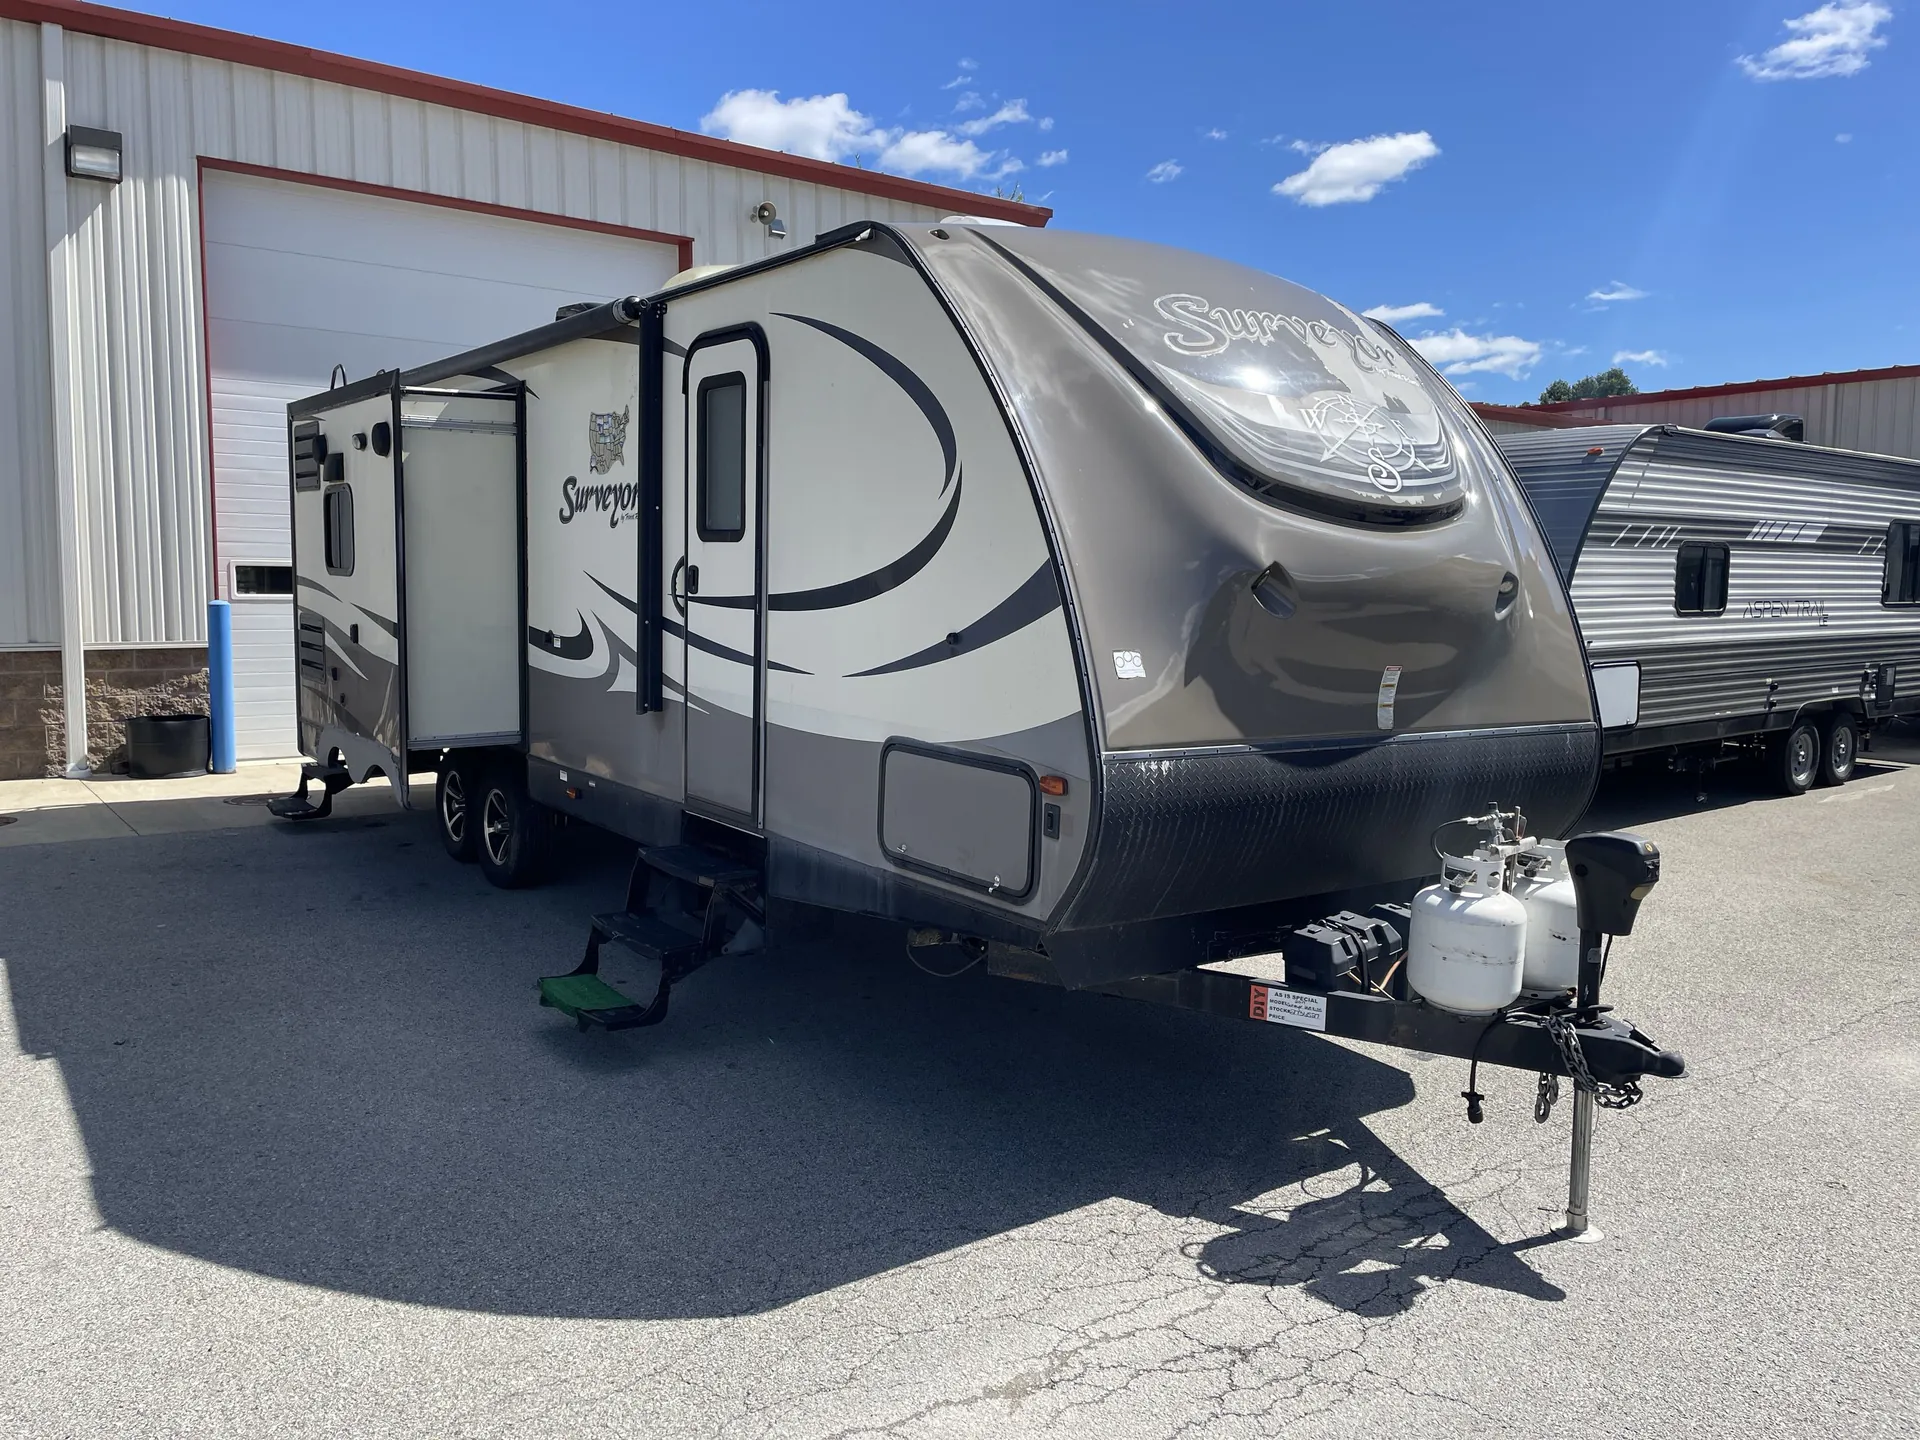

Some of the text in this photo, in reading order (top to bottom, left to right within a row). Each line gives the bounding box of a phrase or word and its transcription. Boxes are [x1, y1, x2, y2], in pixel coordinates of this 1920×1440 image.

[1153, 293, 1396, 373] Surveyor
[1742, 600, 1829, 618] ASPEN TRAIL
[1253, 988, 1266, 1018] DIY
[1292, 995, 1318, 1004] SPECIAL
